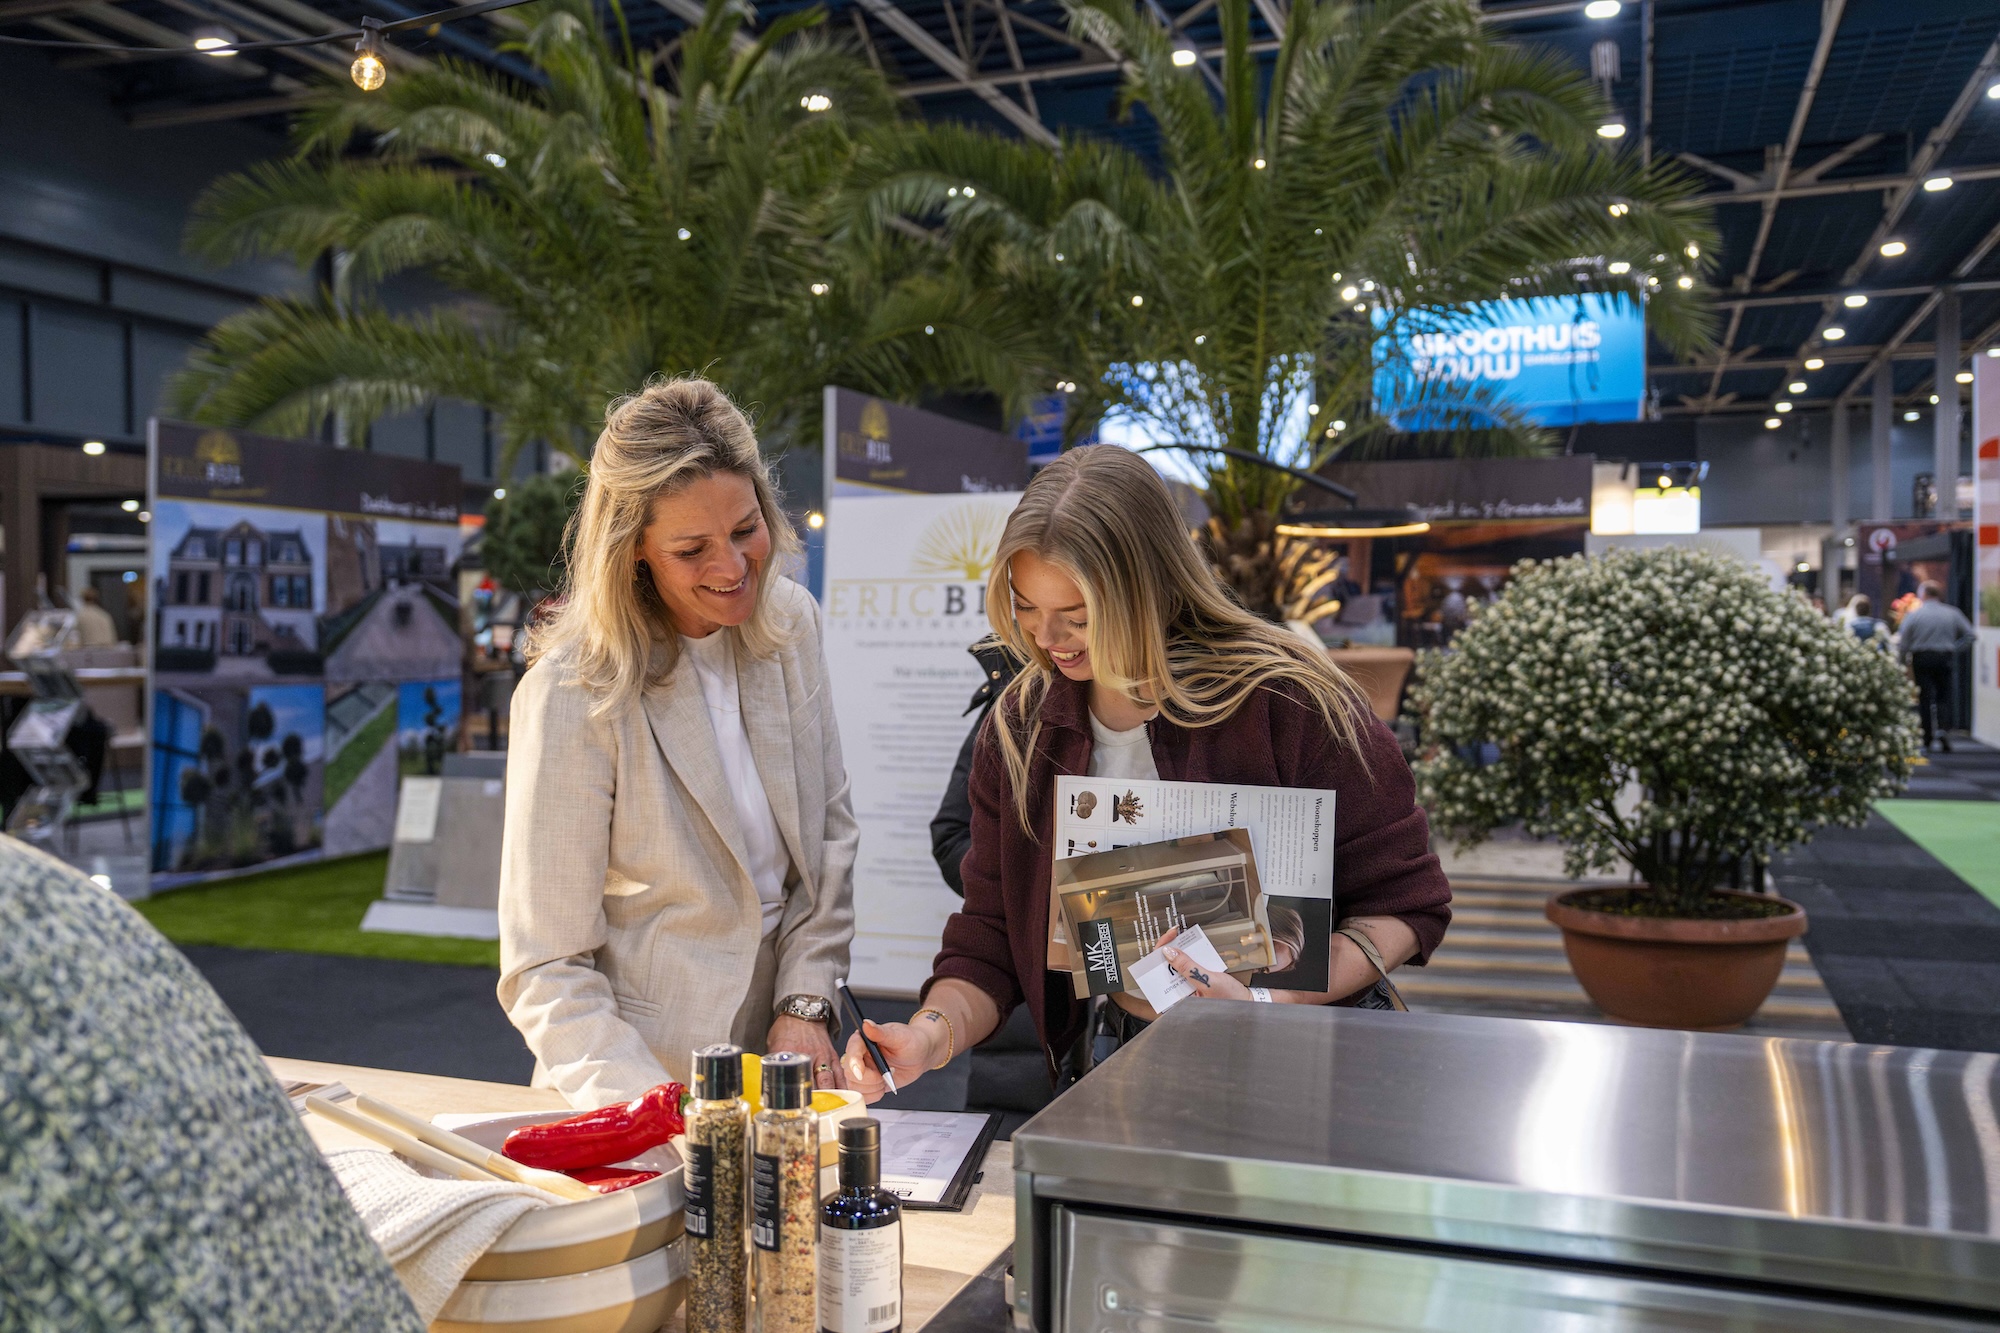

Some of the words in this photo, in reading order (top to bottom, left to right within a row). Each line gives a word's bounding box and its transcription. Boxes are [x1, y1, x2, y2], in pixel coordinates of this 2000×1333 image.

[1228, 792, 1238, 827] Webshop
[1312, 797, 1322, 852] Woonshoppen
[1085, 940, 1105, 972] MK
